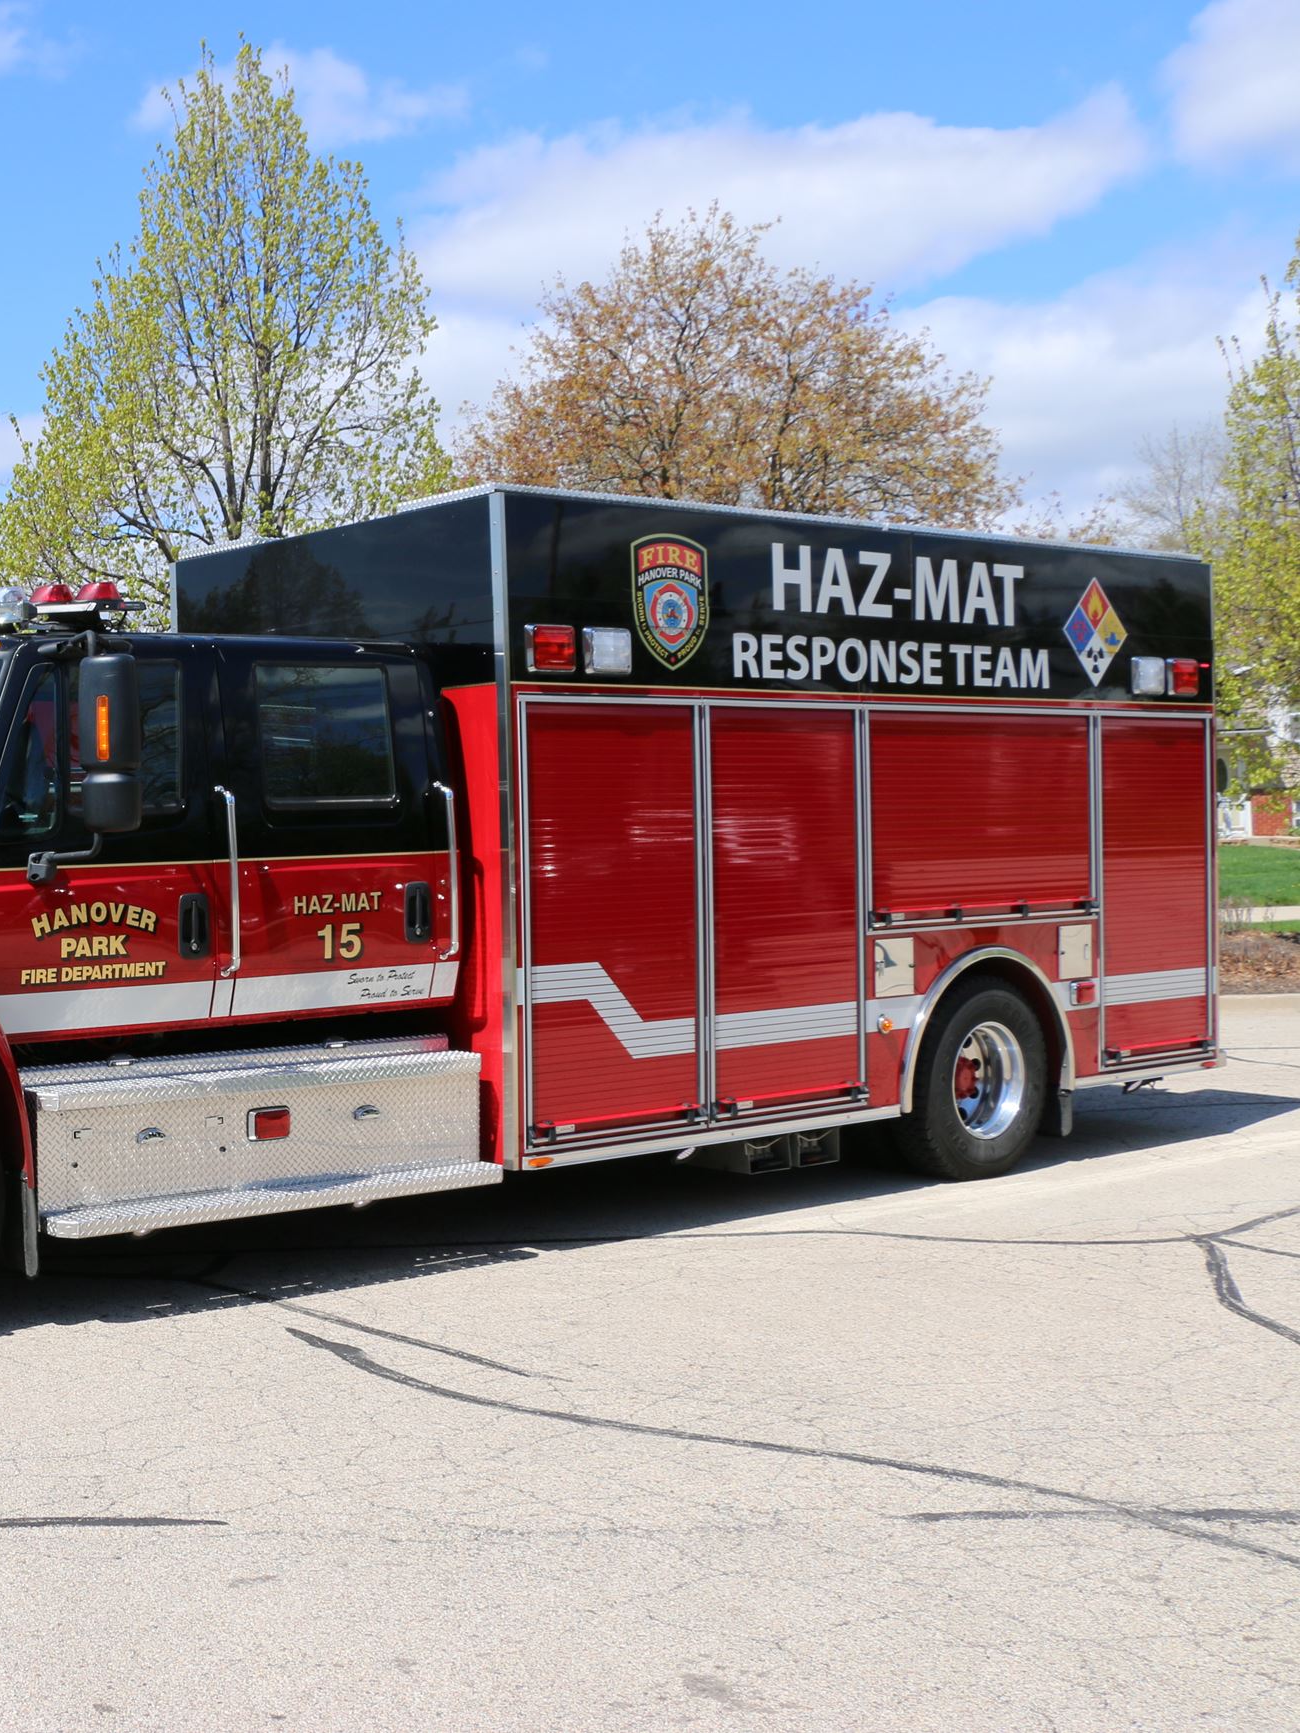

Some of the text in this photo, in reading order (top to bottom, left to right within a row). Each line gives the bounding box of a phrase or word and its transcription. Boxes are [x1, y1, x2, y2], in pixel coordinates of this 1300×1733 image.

[641, 545, 699, 573] FIRE
[638, 566, 702, 590] HANOVER PARK
[771, 542, 1024, 627] HAZ-MAT
[732, 632, 1050, 689] RESPONSE TEAM
[294, 891, 382, 915] HAZ-MAT
[31, 901, 158, 938] HANOVER
[61, 934, 128, 959] PARK
[317, 922, 362, 960] 15
[21, 961, 167, 985] FIRE DEPARTMENT
[376, 974, 384, 982] to
[387, 969, 417, 982] Protect
[360, 985, 425, 1000] Proud to Serve
